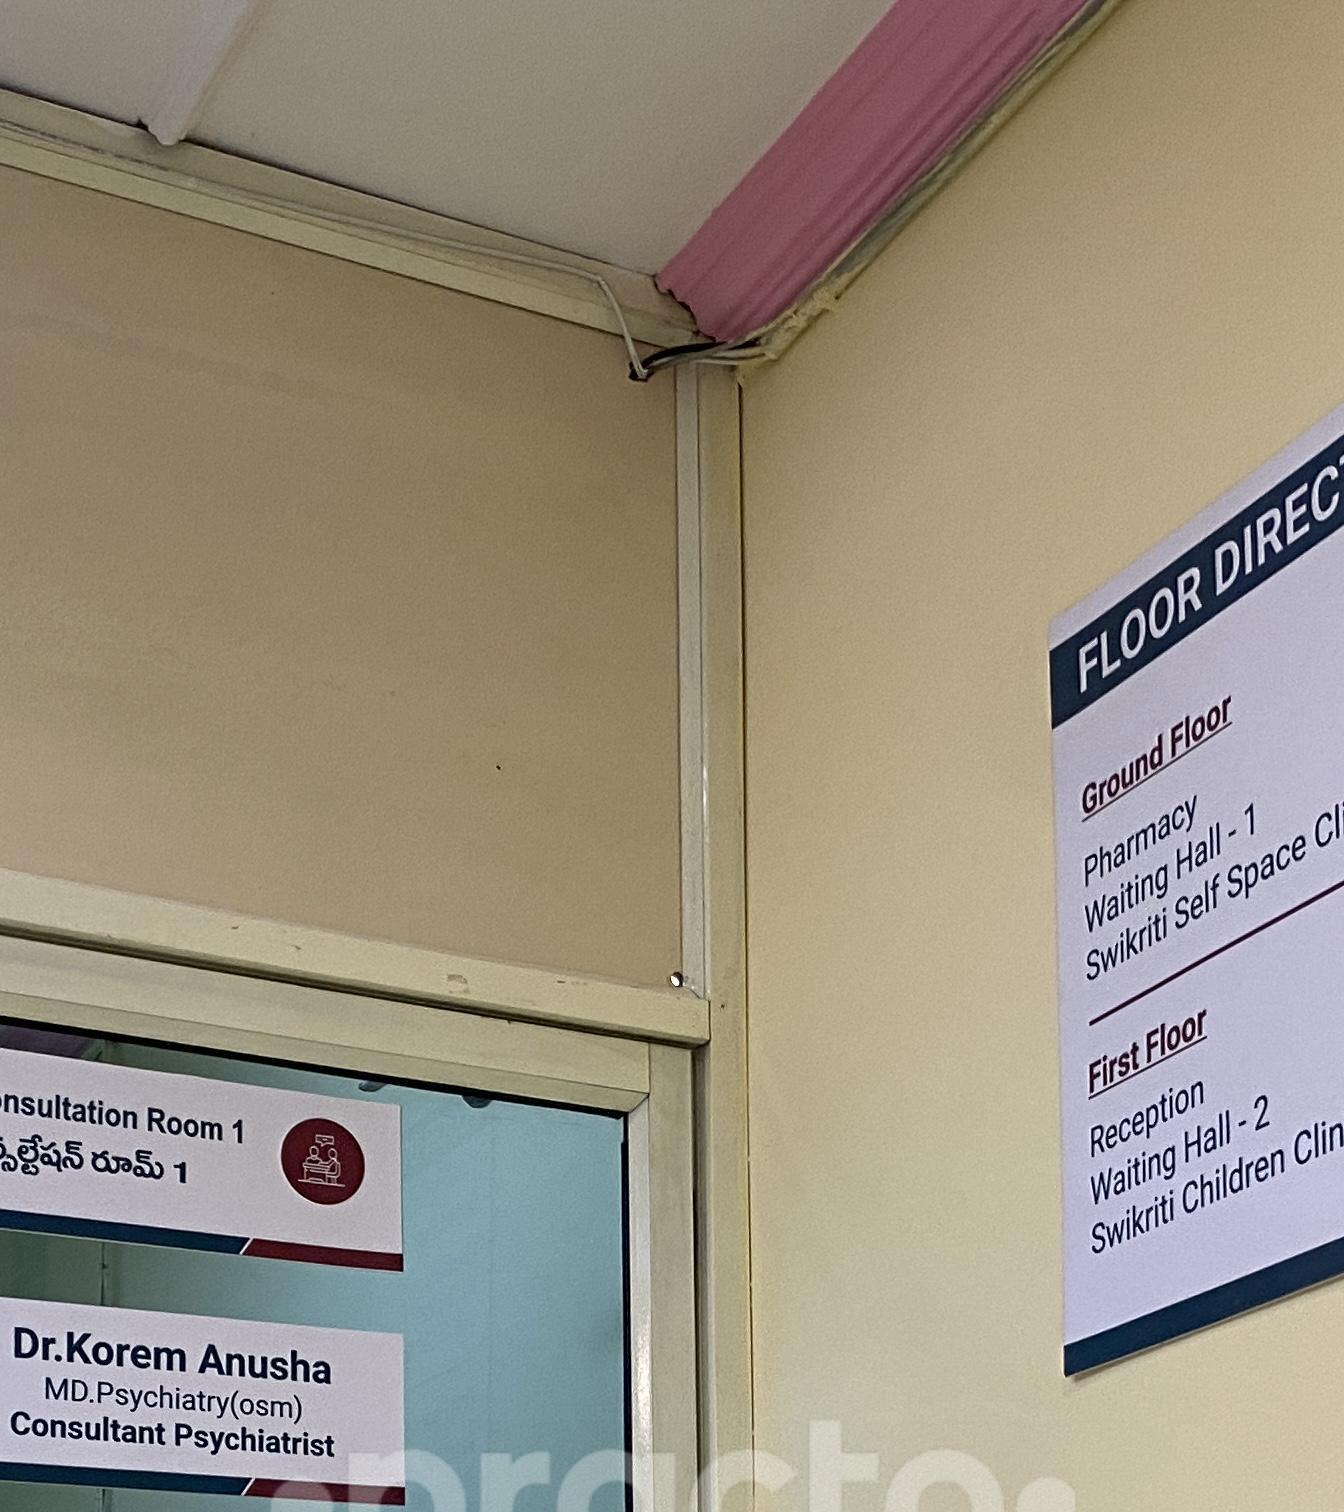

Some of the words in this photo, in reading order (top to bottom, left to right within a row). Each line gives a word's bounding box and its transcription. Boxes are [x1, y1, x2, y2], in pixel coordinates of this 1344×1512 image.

[1079, 566, 1203, 694] FLOOR
[1081, 733, 1166, 814] Ground
[1170, 695, 1233, 759] Floor
[1084, 794, 1198, 888] Pharmacy
[1084, 863, 1169, 933] Waiting
[1176, 826, 1221, 880] Hall
[1244, 802, 1255, 836] 1
[1086, 909, 1168, 981] Swikriti
[1174, 872, 1220, 930] Self
[1227, 834, 1307, 899] Space
[1088, 1041, 1140, 1095] First
[1143, 1008, 1208, 1072] Floor
[147, 1106, 224, 1142] Room
[232, 1119, 243, 1144] 1
[1090, 1080, 1204, 1158] Reception
[1090, 1145, 1176, 1206] Waiting
[1184, 1111, 1231, 1164] Hall
[1253, 1094, 1271, 1132] 2
[90, 1149, 165, 1180] రూమ్
[173, 1161, 187, 1184] 1
[1091, 1189, 1174, 1254] Swikriti
[1182, 1148, 1285, 1214] Children
[13, 1326, 187, 1373] Dr.Korem
[197, 1343, 332, 1385] Anusha
[45, 1376, 303, 1425] MD.Psychiatry(osm)
[10, 1410, 166, 1446] Consultant
[174, 1422, 335, 1458] Psychiatrist
